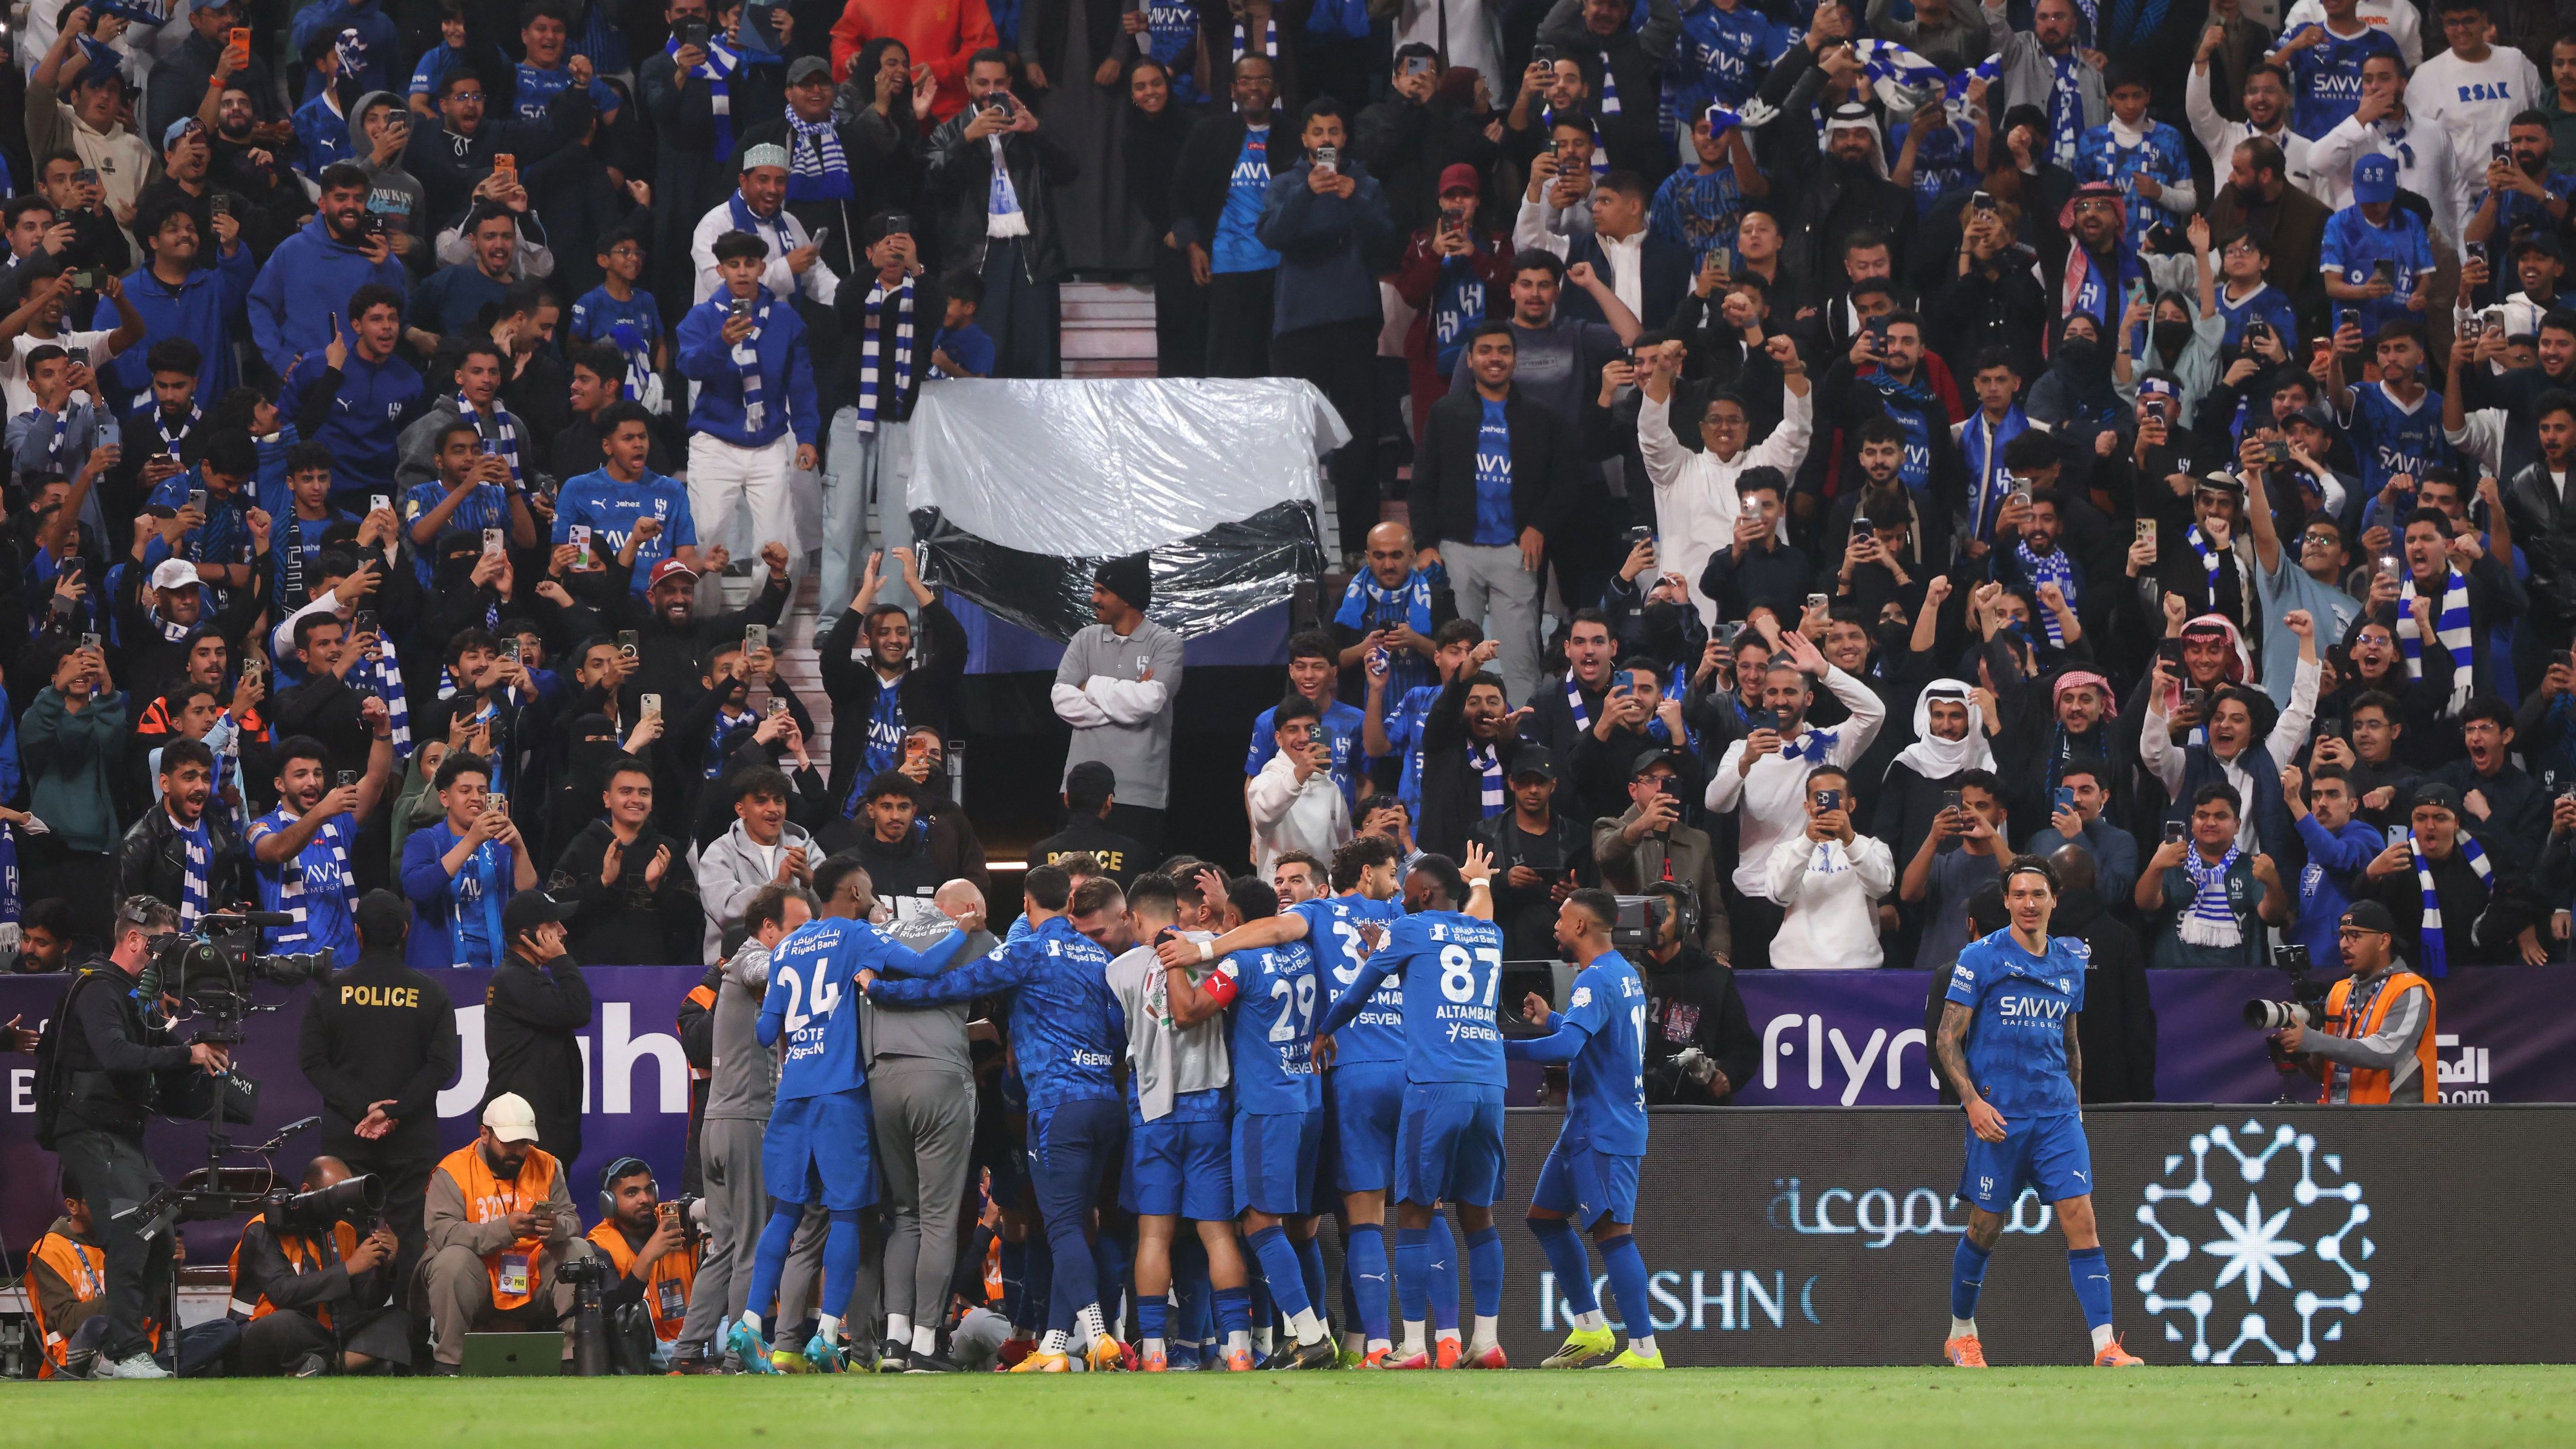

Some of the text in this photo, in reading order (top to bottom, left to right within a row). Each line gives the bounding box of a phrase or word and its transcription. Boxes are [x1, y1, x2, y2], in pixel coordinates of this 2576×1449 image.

[1148, 7, 1192, 25] AVVY
[2313, 74, 2362, 93] SAVV
[2458, 82, 2511, 102] RSAK
[1480, 424, 1507, 434] jahez
[615, 500, 640, 509] jahez
[899, 930, 927, 938] Riyad
[1453, 933, 1497, 944] Riyad Bank
[790, 938, 838, 955] Riyad Bank
[1067, 951, 1090, 962] Riyad
[1439, 944, 1502, 1007] 87
[341, 986, 419, 1009] POLICE
[777, 957, 843, 1033] 24
[1268, 974, 1316, 1042] 29
[2000, 996, 2070, 1020] SAVVY
[1359, 1011, 1401, 1025] SEVEN
[2040, 1021, 2062, 1029] GROU
[1461, 1026, 1497, 1041] SEVEN
[1082, 1053, 1112, 1066] SEVEN
[1763, 1013, 1940, 1107] flyn
